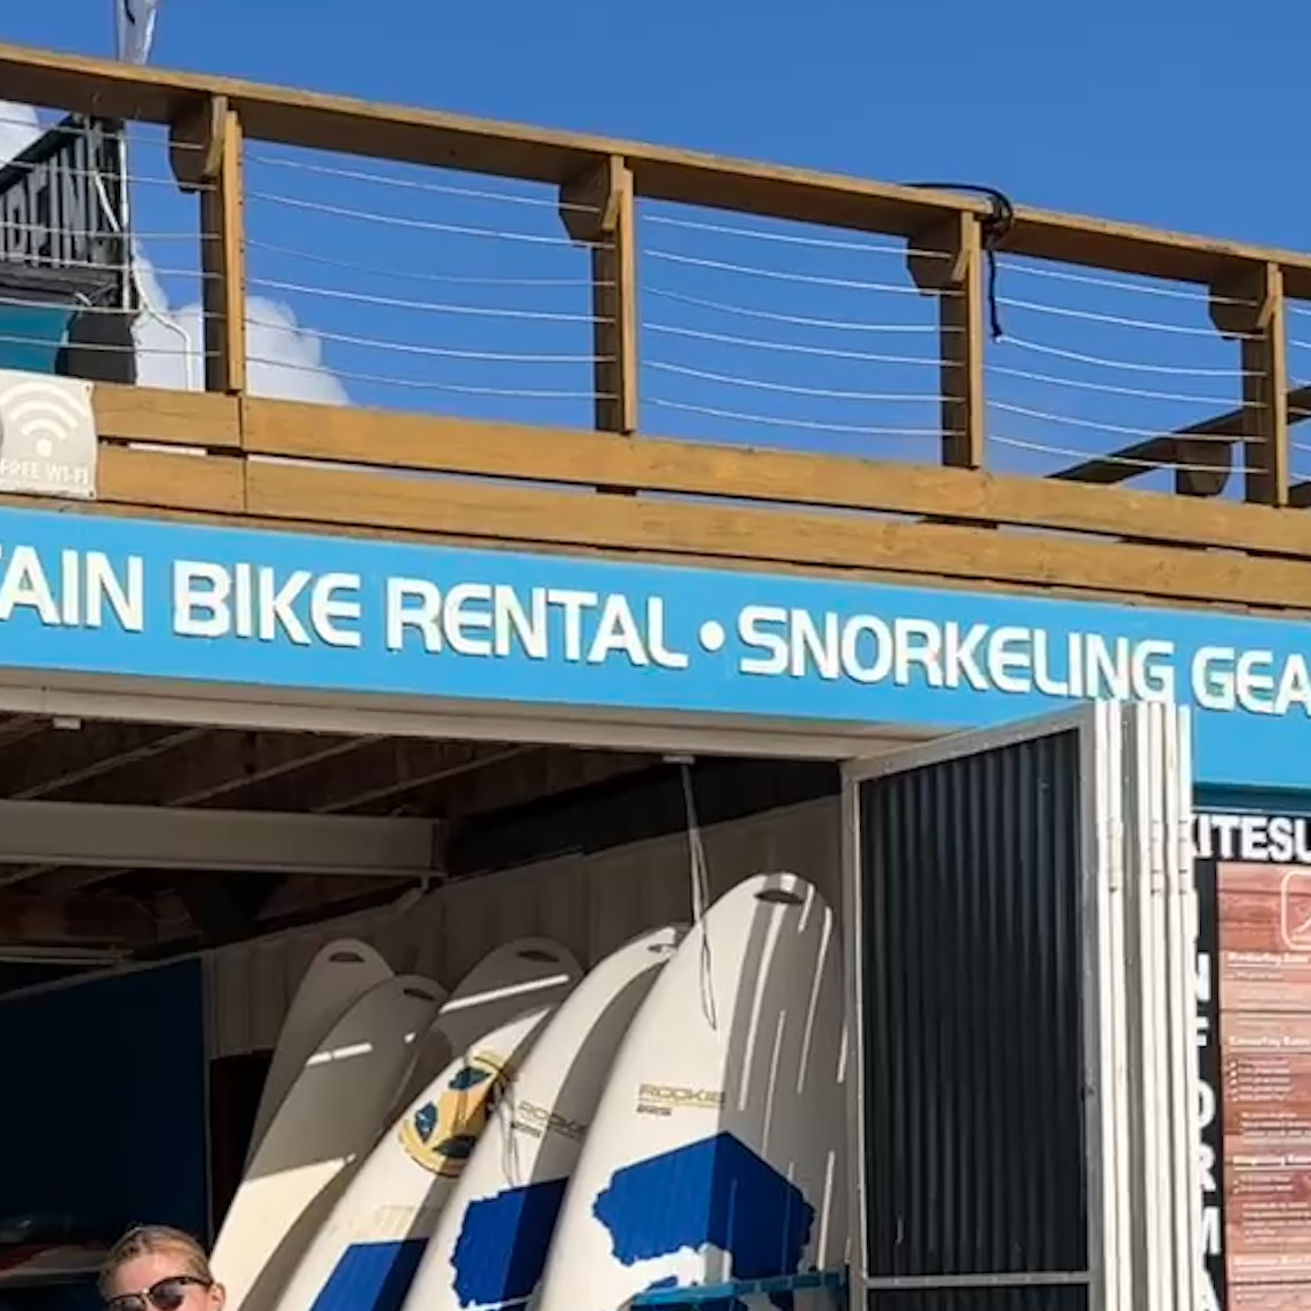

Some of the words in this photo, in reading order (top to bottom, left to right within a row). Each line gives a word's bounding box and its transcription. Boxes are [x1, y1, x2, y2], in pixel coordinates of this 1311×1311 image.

[174, 560, 362, 647] BIKE
[387, 577, 689, 668] RENTAL
[738, 605, 1176, 702] SNORKELING
[1189, 813, 1311, 863] ITESU
